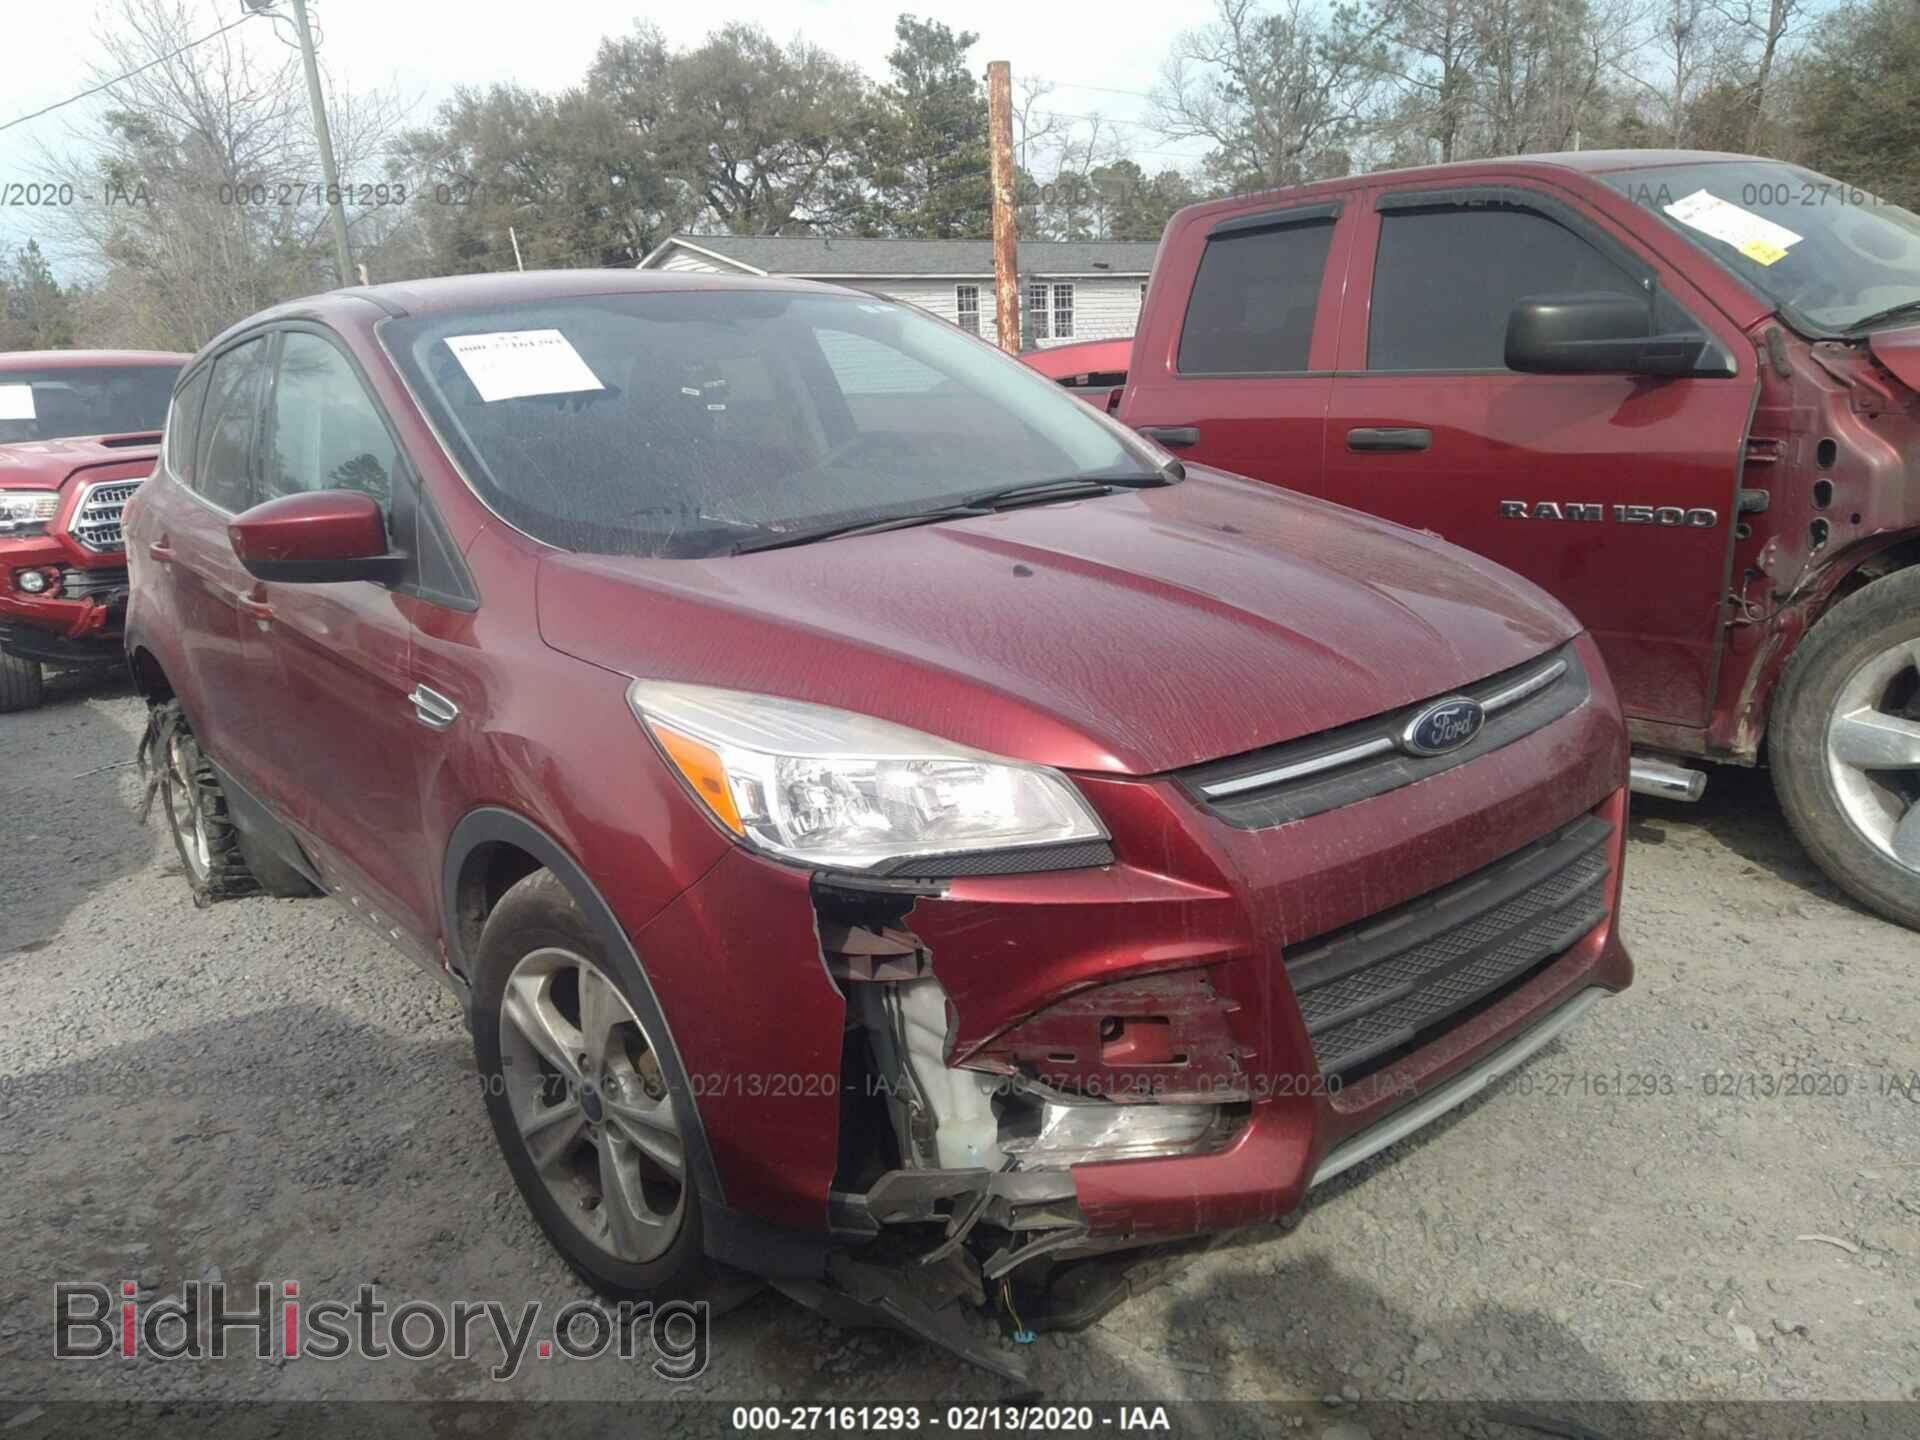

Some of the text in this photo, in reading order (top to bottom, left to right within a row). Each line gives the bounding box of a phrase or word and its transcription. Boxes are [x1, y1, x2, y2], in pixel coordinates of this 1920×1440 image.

[1500, 499, 1718, 528] RAM 1500
[1431, 707, 1473, 746] Ford
